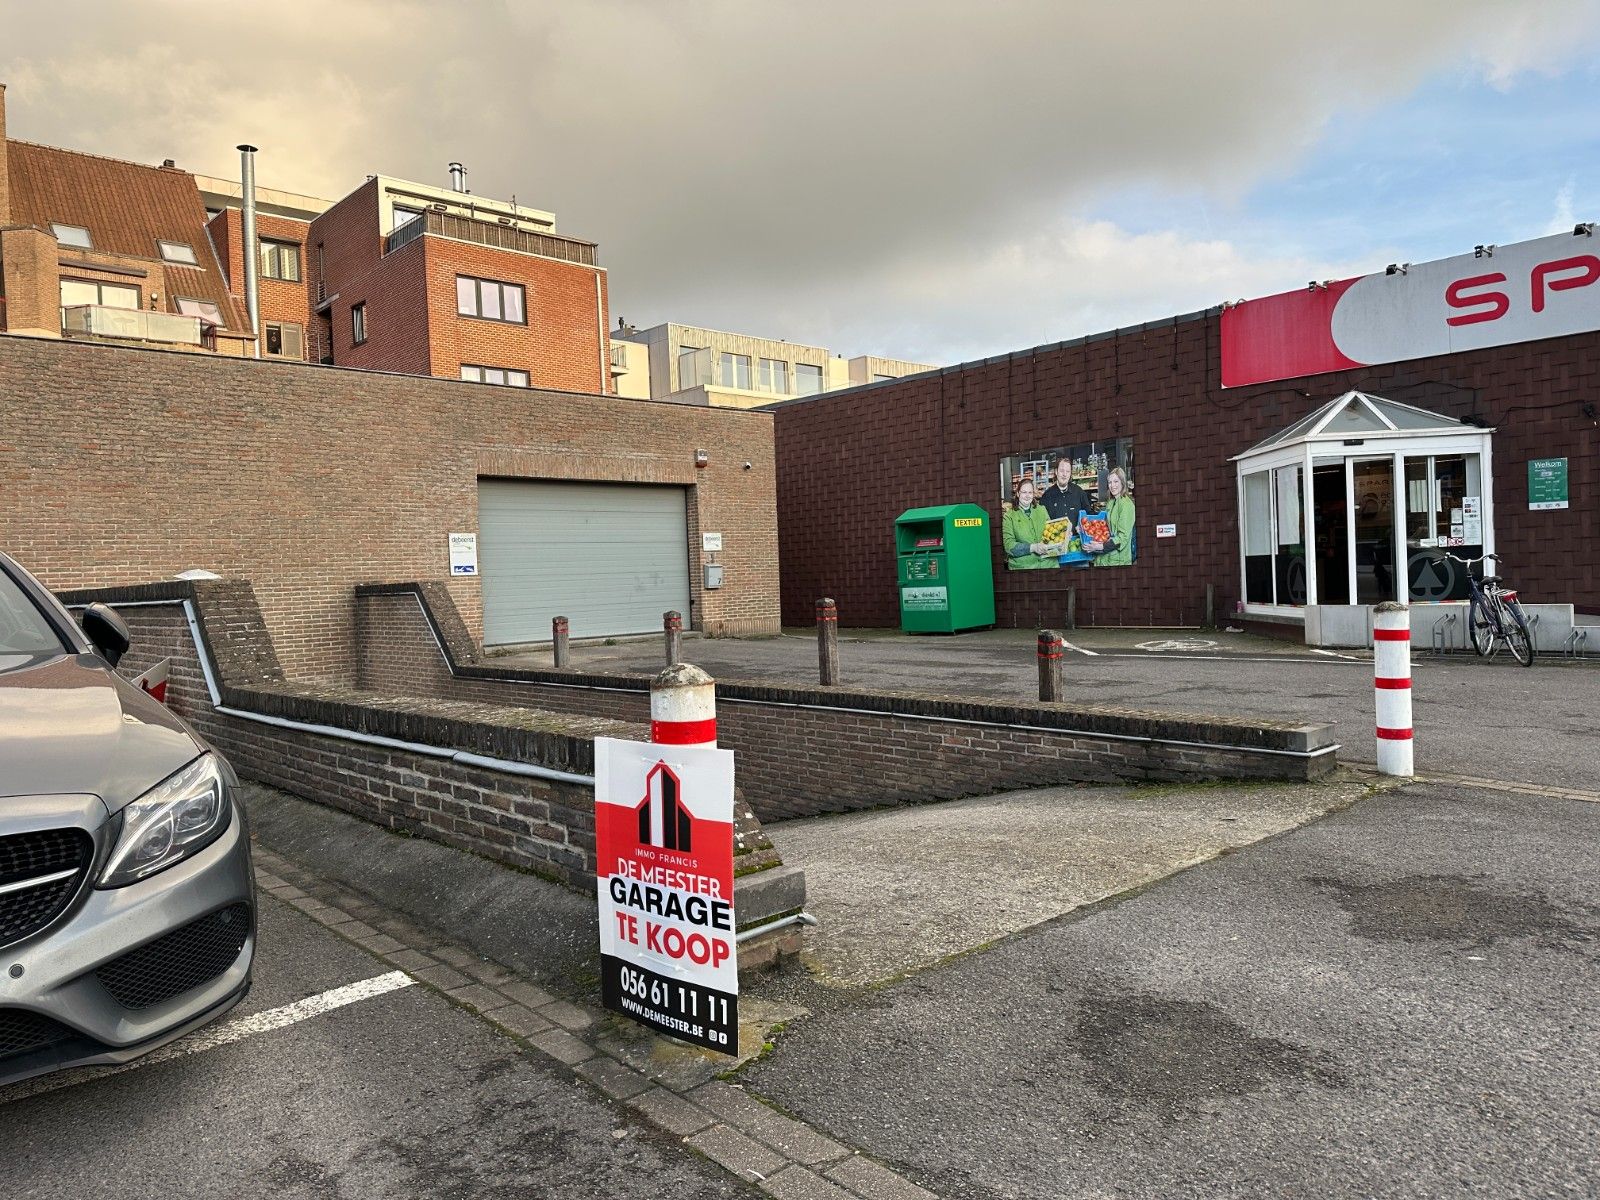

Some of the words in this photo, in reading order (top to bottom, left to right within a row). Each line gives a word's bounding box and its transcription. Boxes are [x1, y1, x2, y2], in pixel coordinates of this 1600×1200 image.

[1445, 254, 1600, 327] SP
[1534, 461, 1562, 469] Welkom
[956, 519, 981, 527] TEXTIEL
[617, 857, 638, 880] DE
[640, 863, 721, 900] MEESTER
[635, 848, 656, 860] IMMO
[659, 853, 698, 869] FRANCIS
[609, 877, 731, 931] GARAGE
[616, 910, 639, 945] TE
[646, 921, 730, 968] KOOP
[620, 966, 647, 999] 056
[650, 979, 669, 1008] 61
[678, 987, 698, 1017] 11
[708, 994, 728, 1026] 11
[621, 996, 704, 1038] WWW.DEMEESTER.BE
